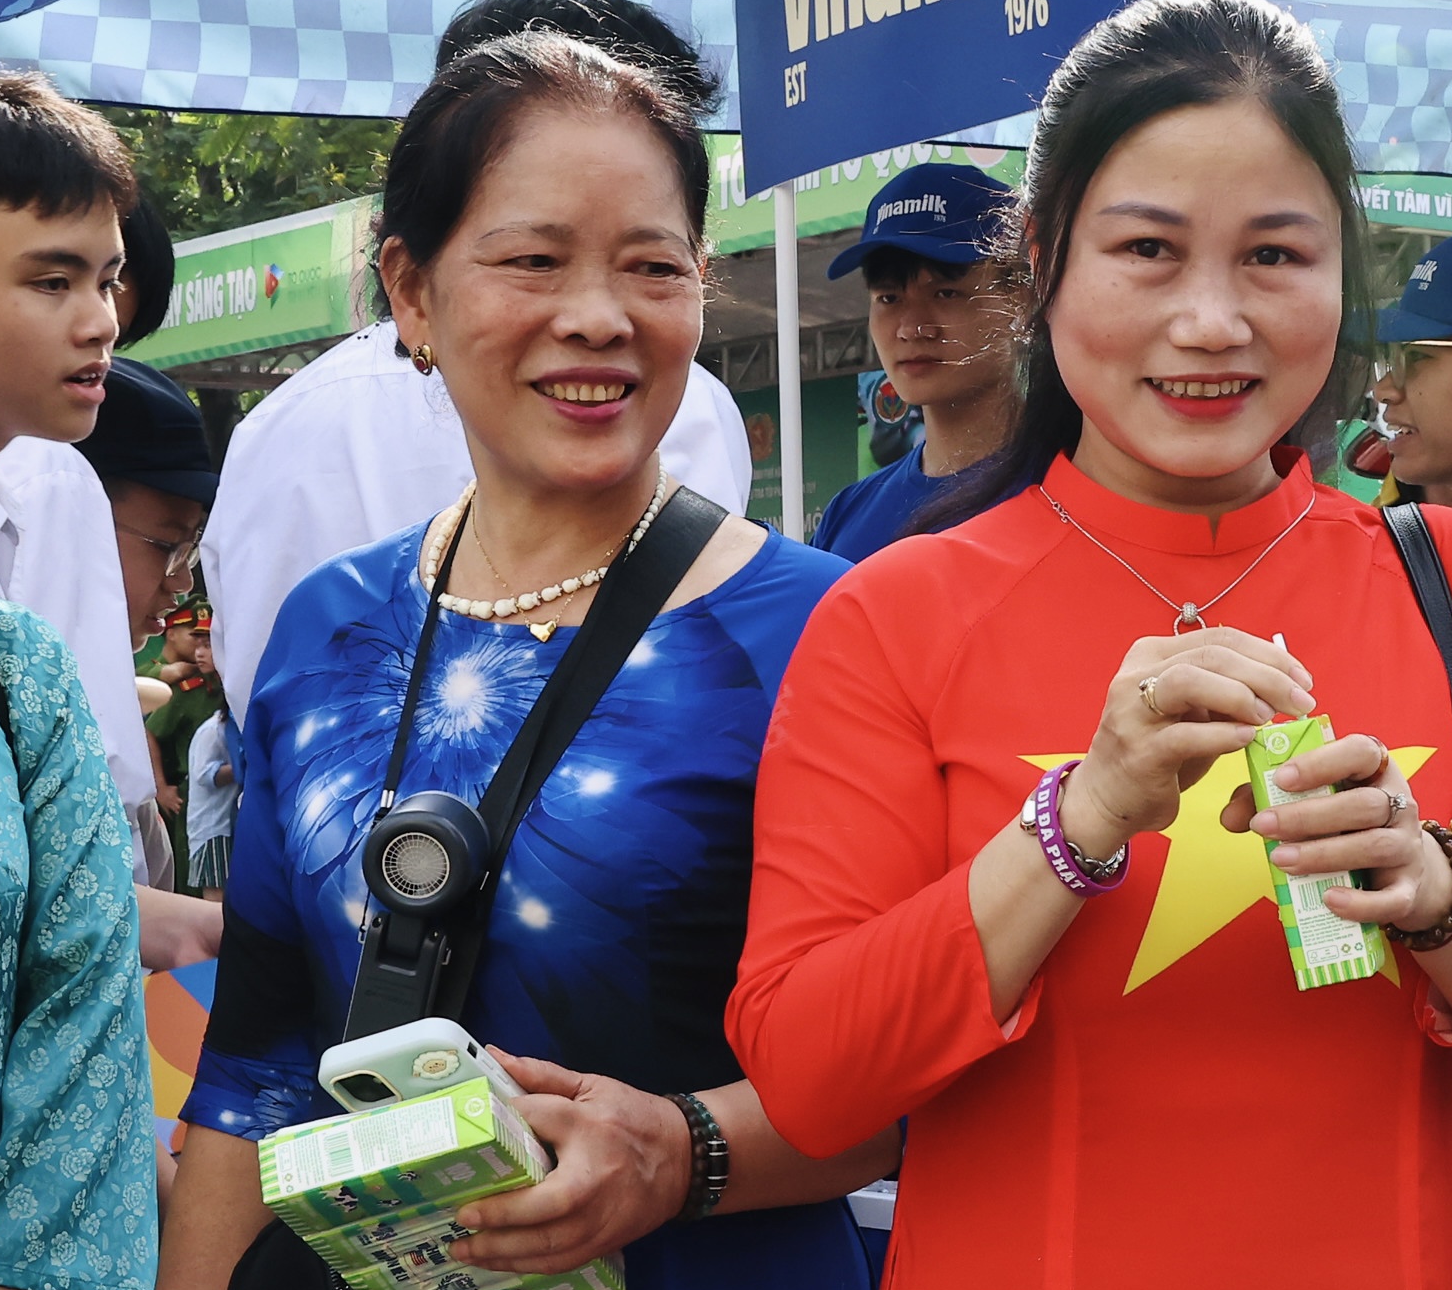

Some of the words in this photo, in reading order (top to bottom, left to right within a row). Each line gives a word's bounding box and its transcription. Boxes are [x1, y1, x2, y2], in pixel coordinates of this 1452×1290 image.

[784, 59, 808, 109] EST
[1394, 187, 1431, 216] TÂM
[1435, 192, 1452, 218] VÌ
[185, 270, 224, 325] SÁNG
[226, 265, 258, 320] TẠO
